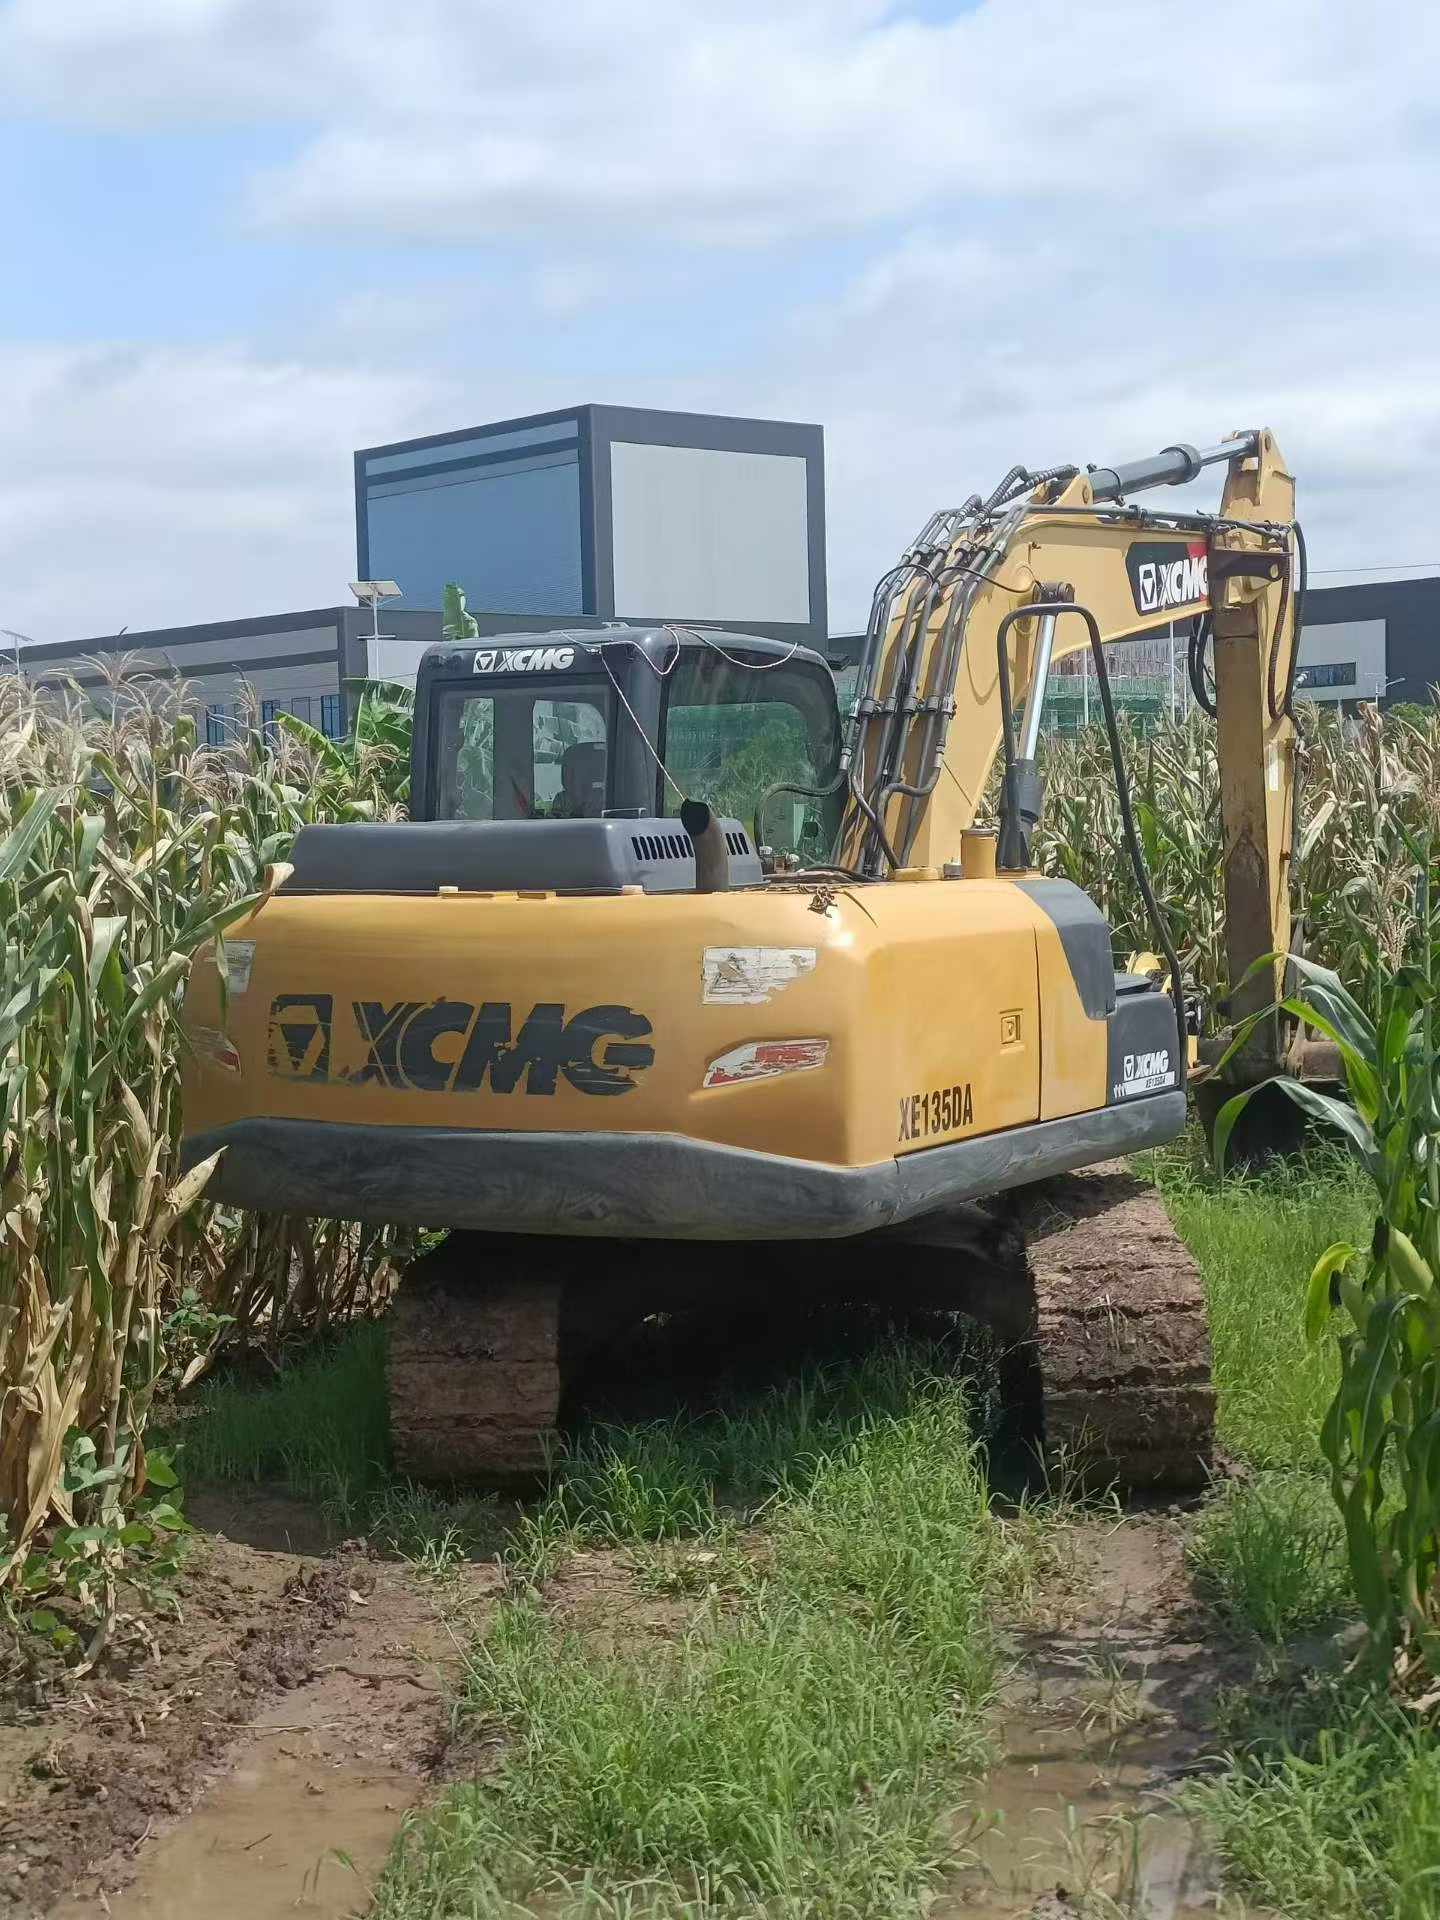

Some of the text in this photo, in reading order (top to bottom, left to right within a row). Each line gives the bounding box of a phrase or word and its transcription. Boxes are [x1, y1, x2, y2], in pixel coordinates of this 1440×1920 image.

[495, 648, 575, 672] XCMG
[352, 1001, 655, 1096] XCMG
[1135, 1050, 1169, 1078] XCMG
[899, 1083, 973, 1141] XE135DA
